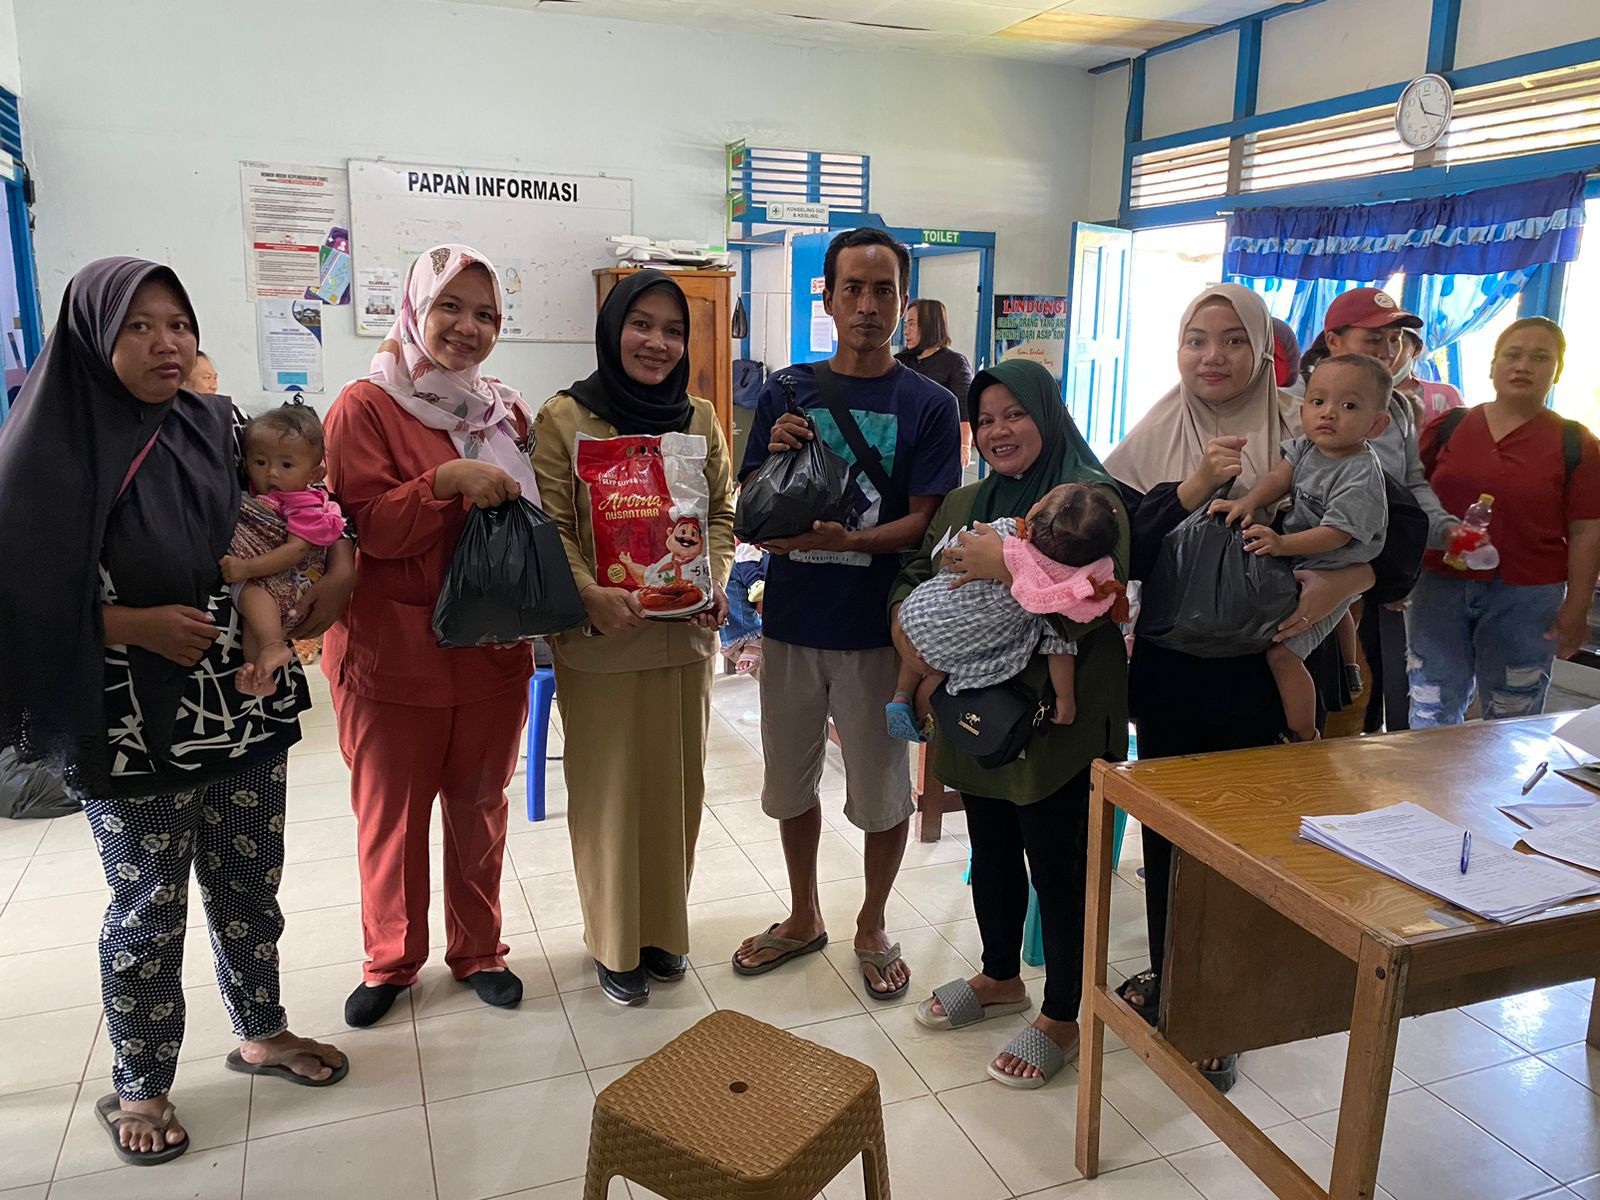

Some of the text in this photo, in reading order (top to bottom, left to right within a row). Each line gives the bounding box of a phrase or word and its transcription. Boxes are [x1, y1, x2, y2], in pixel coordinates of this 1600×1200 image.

[408, 171, 578, 203] PAPAN INFORMASI
[923, 230, 959, 243] TOILET
[1040, 317, 1055, 328] YANG
[1022, 330, 1035, 340] DARI
[1037, 330, 1052, 340] ASAP
[598, 492, 663, 511] Aroma
[605, 508, 659, 520] NUSANTARA
